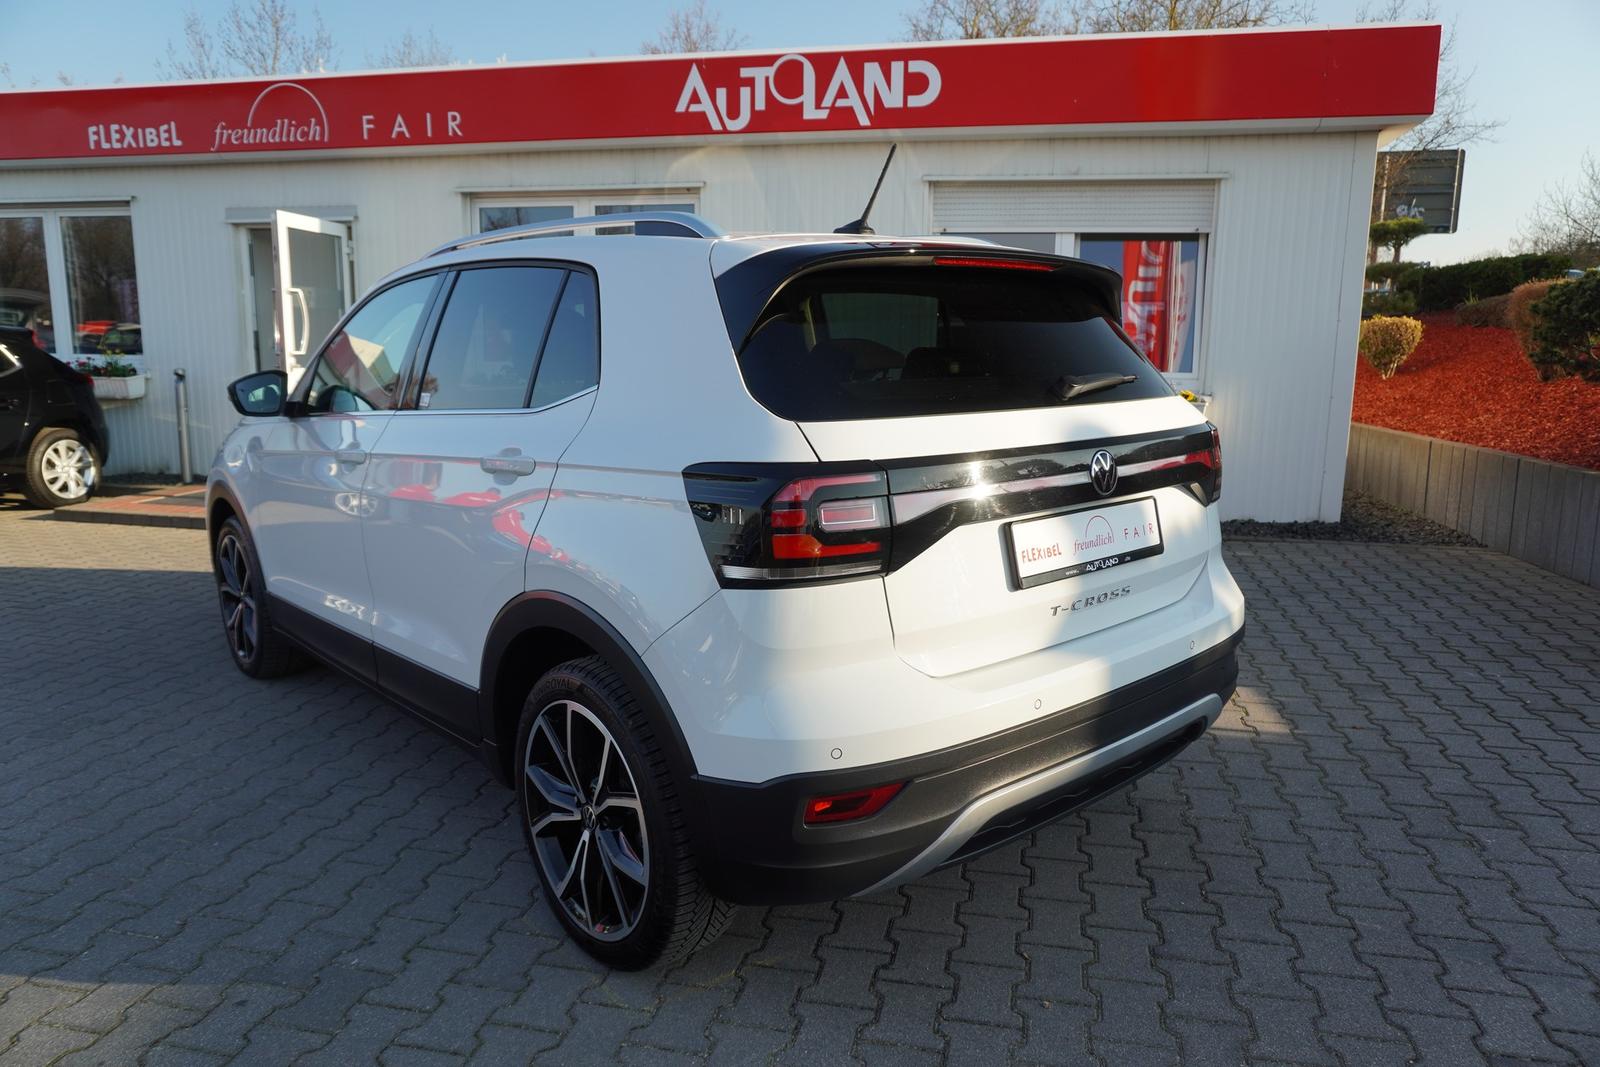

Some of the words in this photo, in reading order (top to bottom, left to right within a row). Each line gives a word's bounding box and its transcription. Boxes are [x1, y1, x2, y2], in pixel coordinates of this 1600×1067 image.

[674, 53, 942, 132] AUTOLAND
[88, 121, 183, 150] FLEXIBEL
[210, 117, 321, 151] freundlich
[362, 111, 464, 140] FAIR
[1021, 542, 1062, 563] FLEXIBEL
[1073, 532, 1113, 556] freundlich
[1123, 523, 1154, 540] FAIR
[1086, 557, 1119, 572] AUTOLAND
[1050, 585, 1131, 617] T-CROSS
